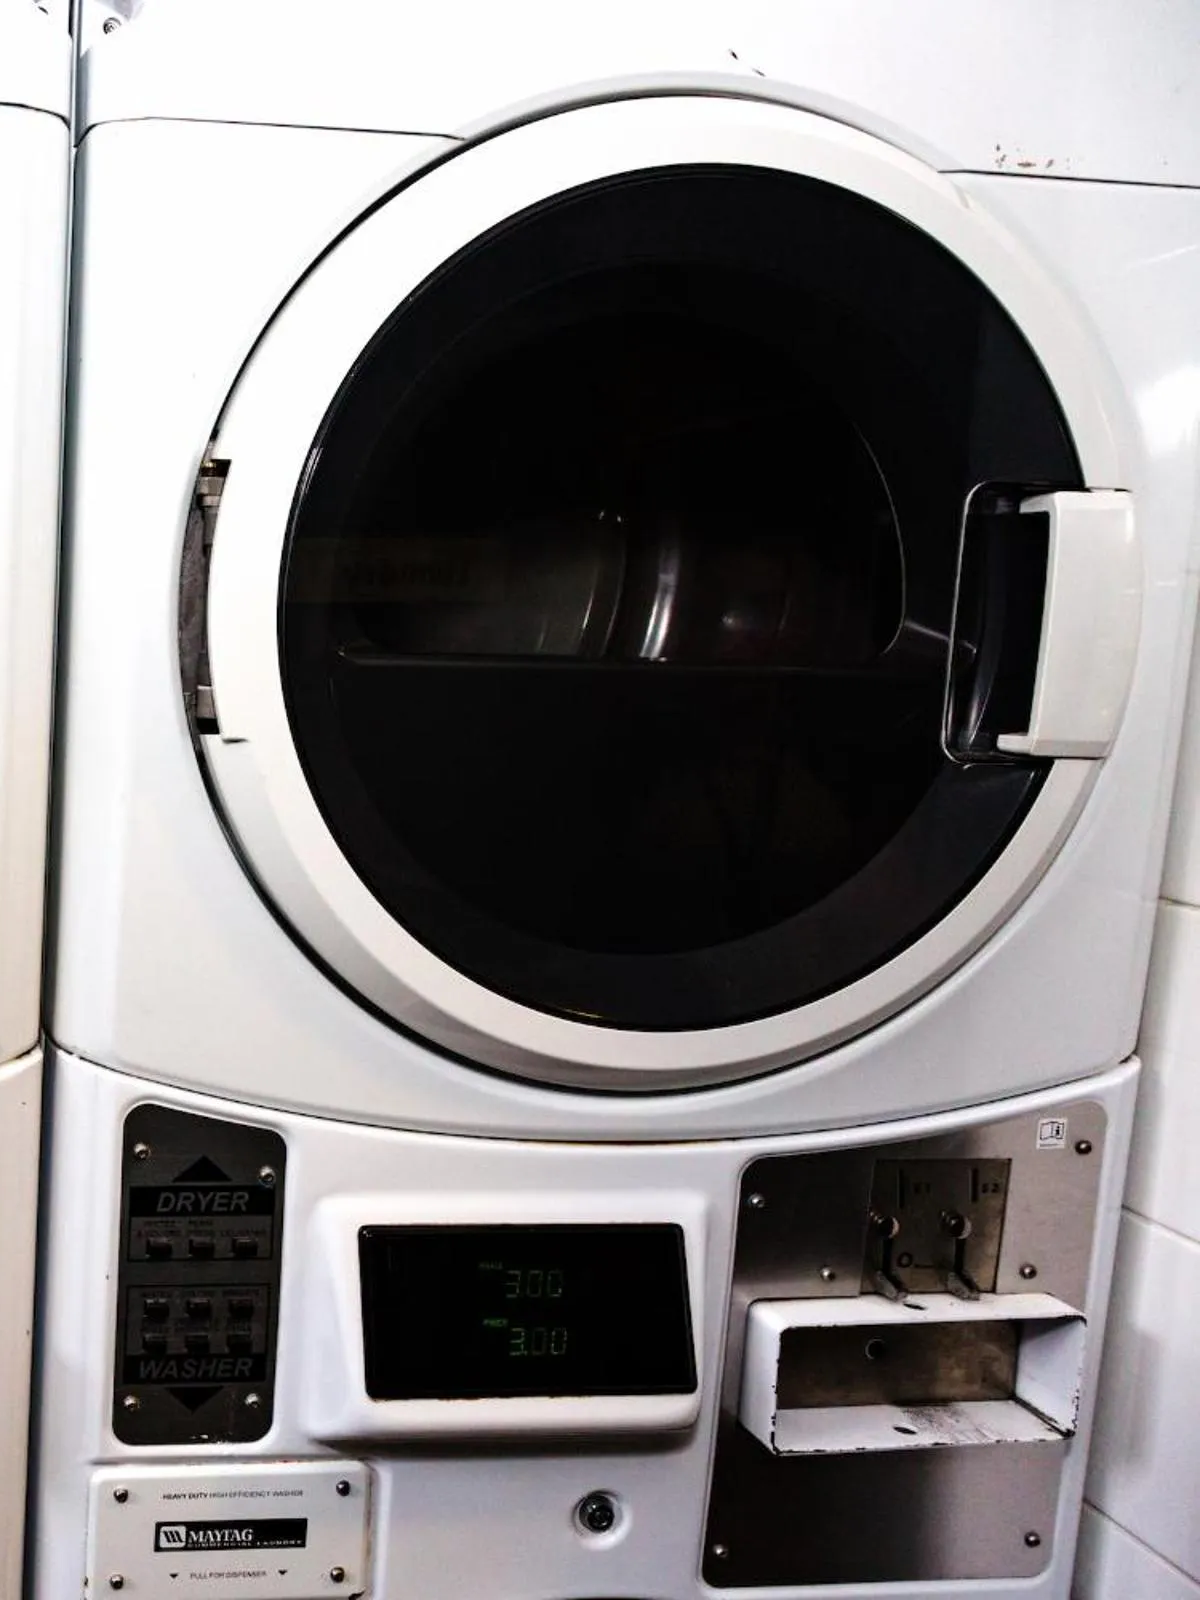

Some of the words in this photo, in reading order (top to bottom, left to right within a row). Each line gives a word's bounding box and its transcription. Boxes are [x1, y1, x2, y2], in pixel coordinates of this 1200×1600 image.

[156, 1191, 249, 1213] DRYER
[139, 1357, 254, 1379] WASHER
[162, 1492, 187, 1500] HEAVY
[188, 1492, 208, 1500] DUTY
[188, 1528, 254, 1542] MAYTAG
